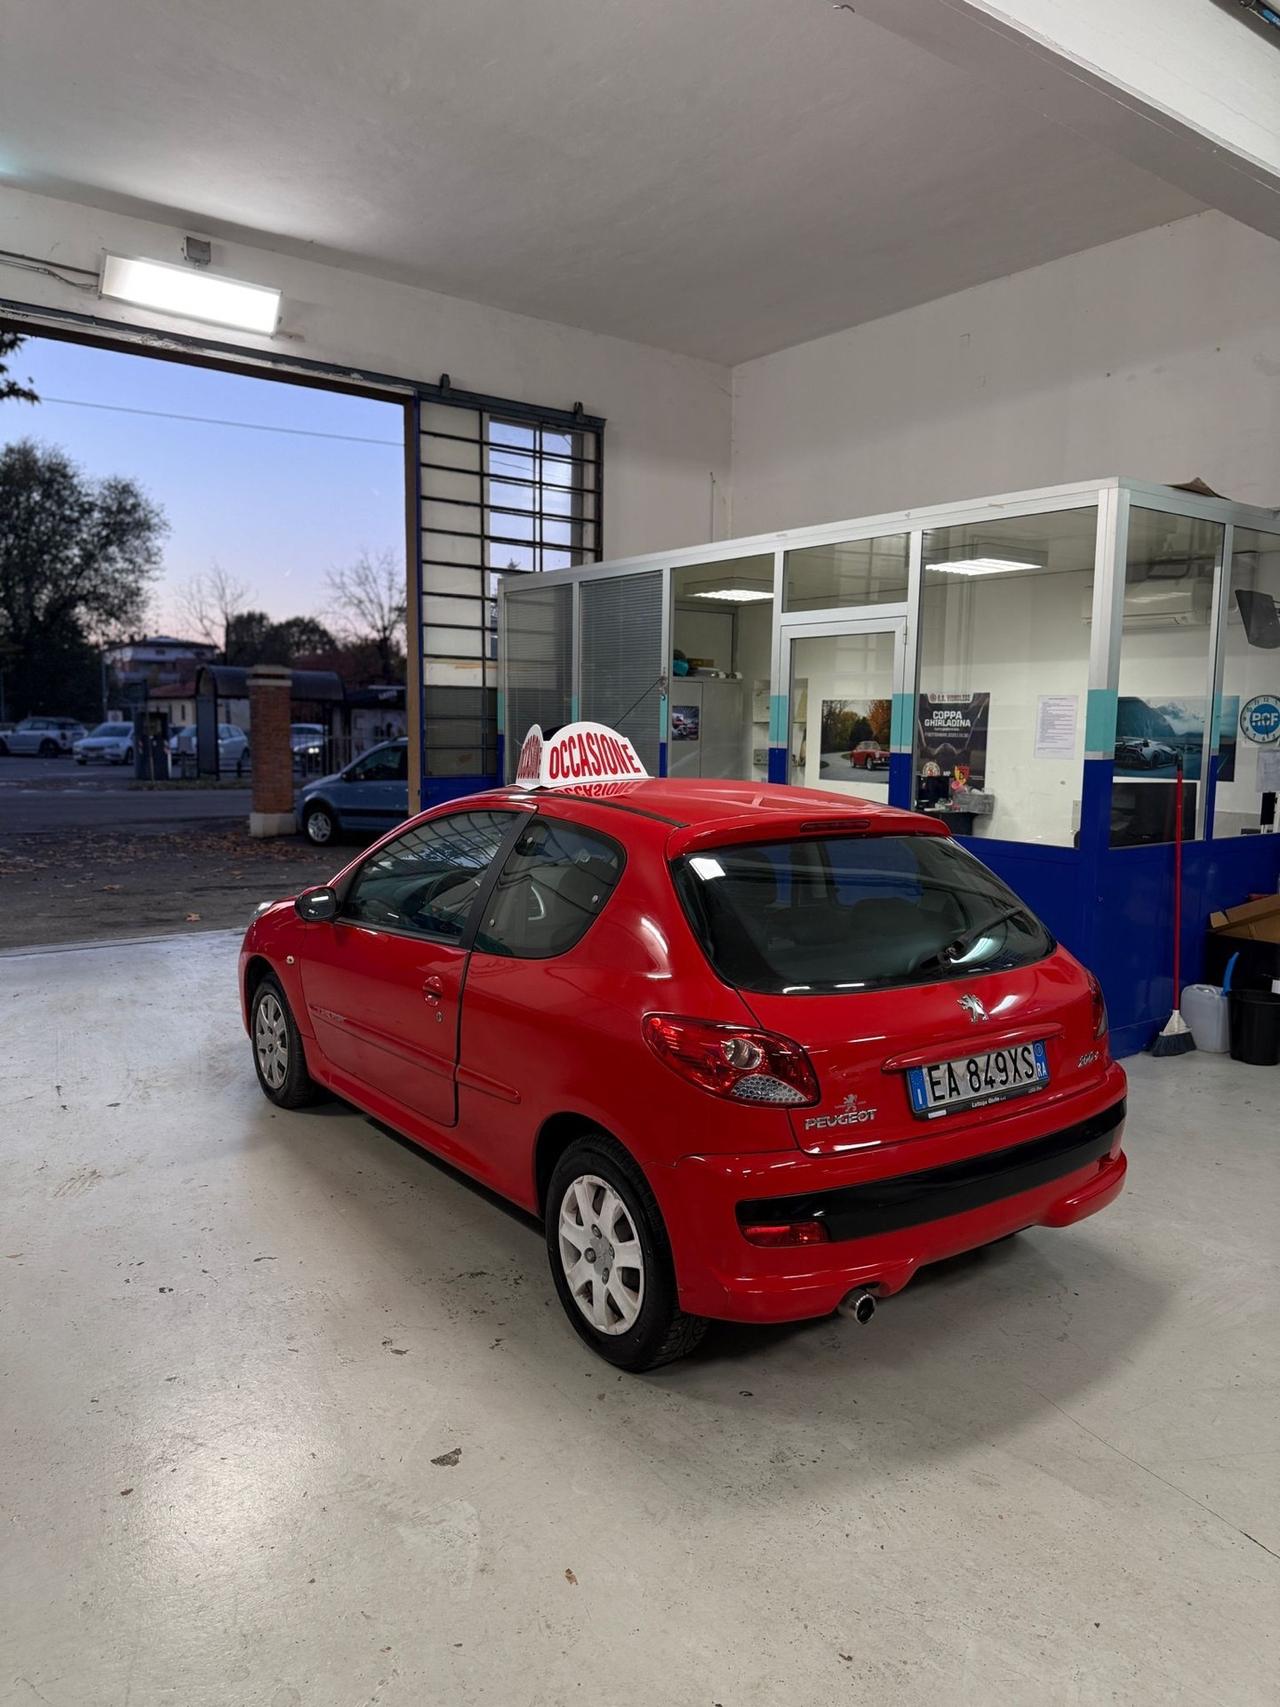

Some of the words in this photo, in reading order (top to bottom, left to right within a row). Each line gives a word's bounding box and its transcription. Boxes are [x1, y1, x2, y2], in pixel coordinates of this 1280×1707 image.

[932, 710, 963, 720] COPPA
[1251, 712, 1278, 726] RCF
[549, 731, 641, 779] OCCASIONE
[1036, 1062, 1047, 1077] RA
[928, 1063, 961, 1101] EA
[804, 1108, 877, 1130] PEUGEOT
